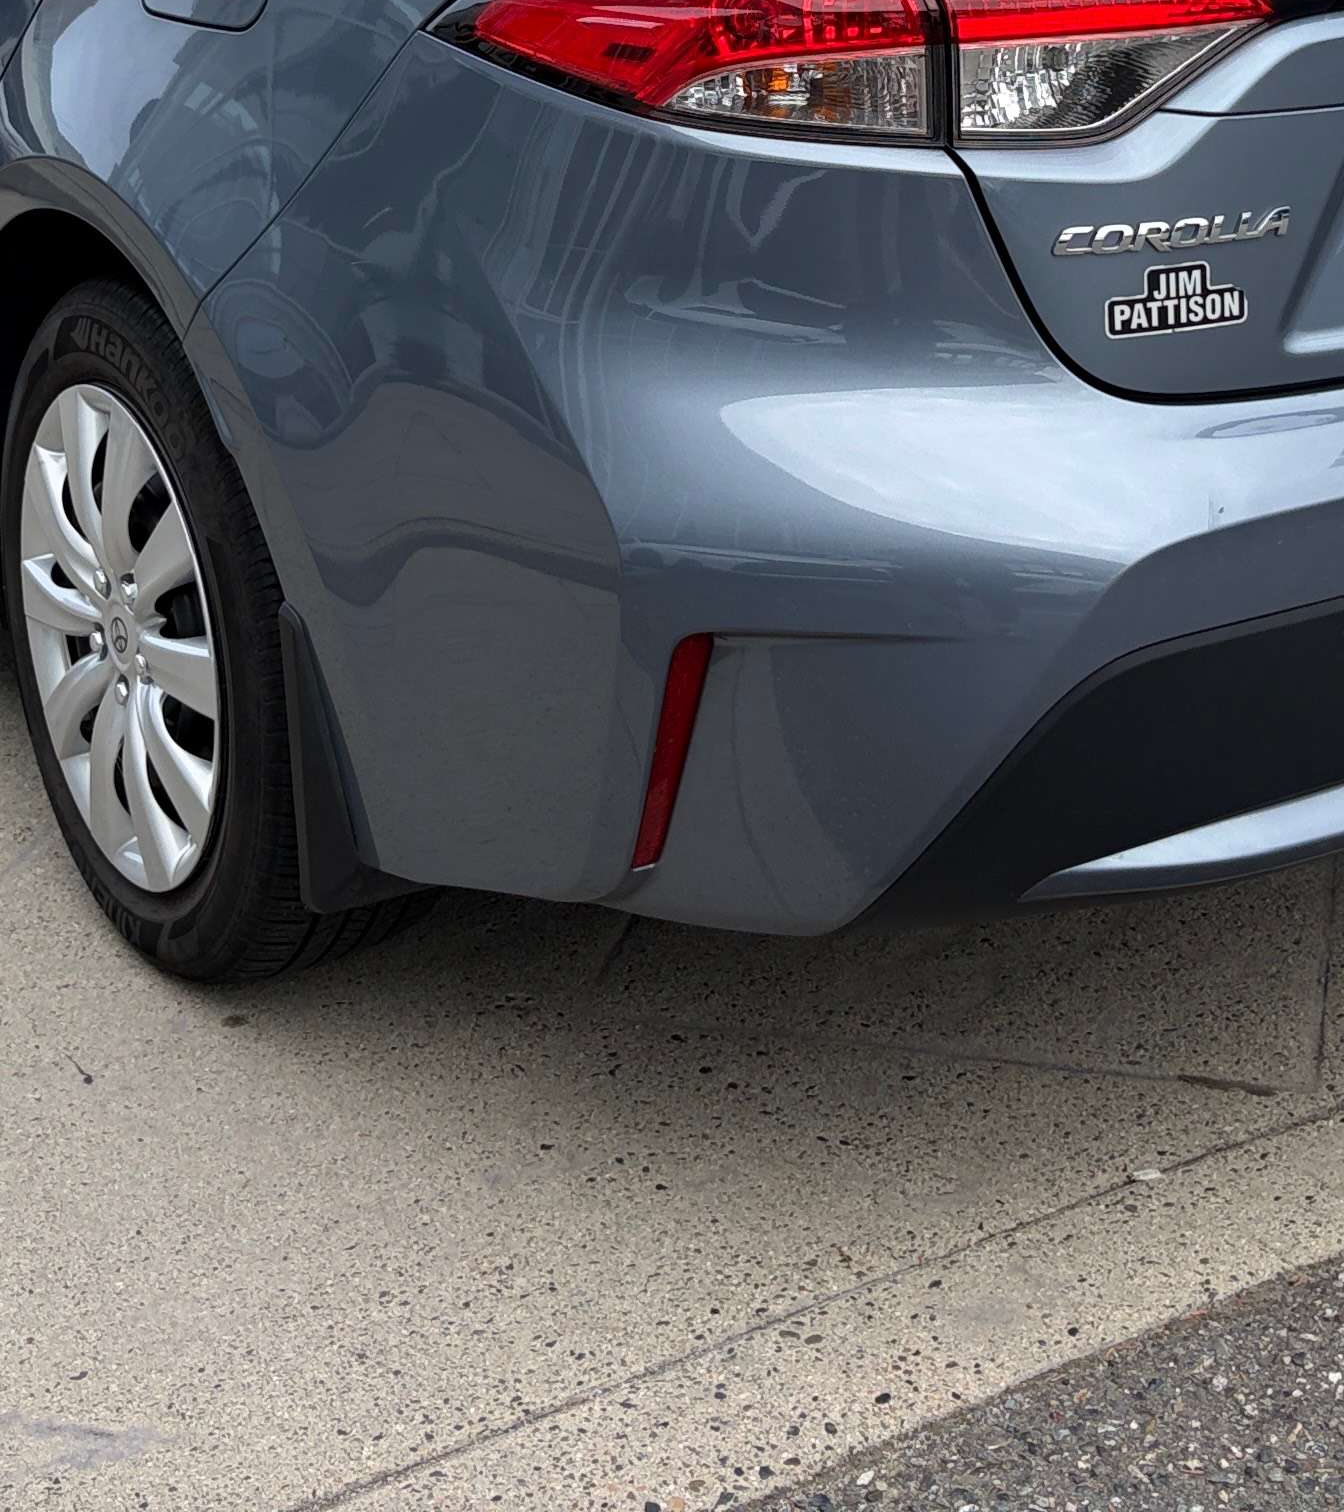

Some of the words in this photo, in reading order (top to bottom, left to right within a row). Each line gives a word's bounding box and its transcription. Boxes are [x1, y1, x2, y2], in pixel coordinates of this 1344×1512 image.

[1052, 206, 1292, 256] COROLLA
[1153, 269, 1202, 300] JIM
[1113, 290, 1241, 331] PATTISON
[88, 322, 190, 463] Hankoo
